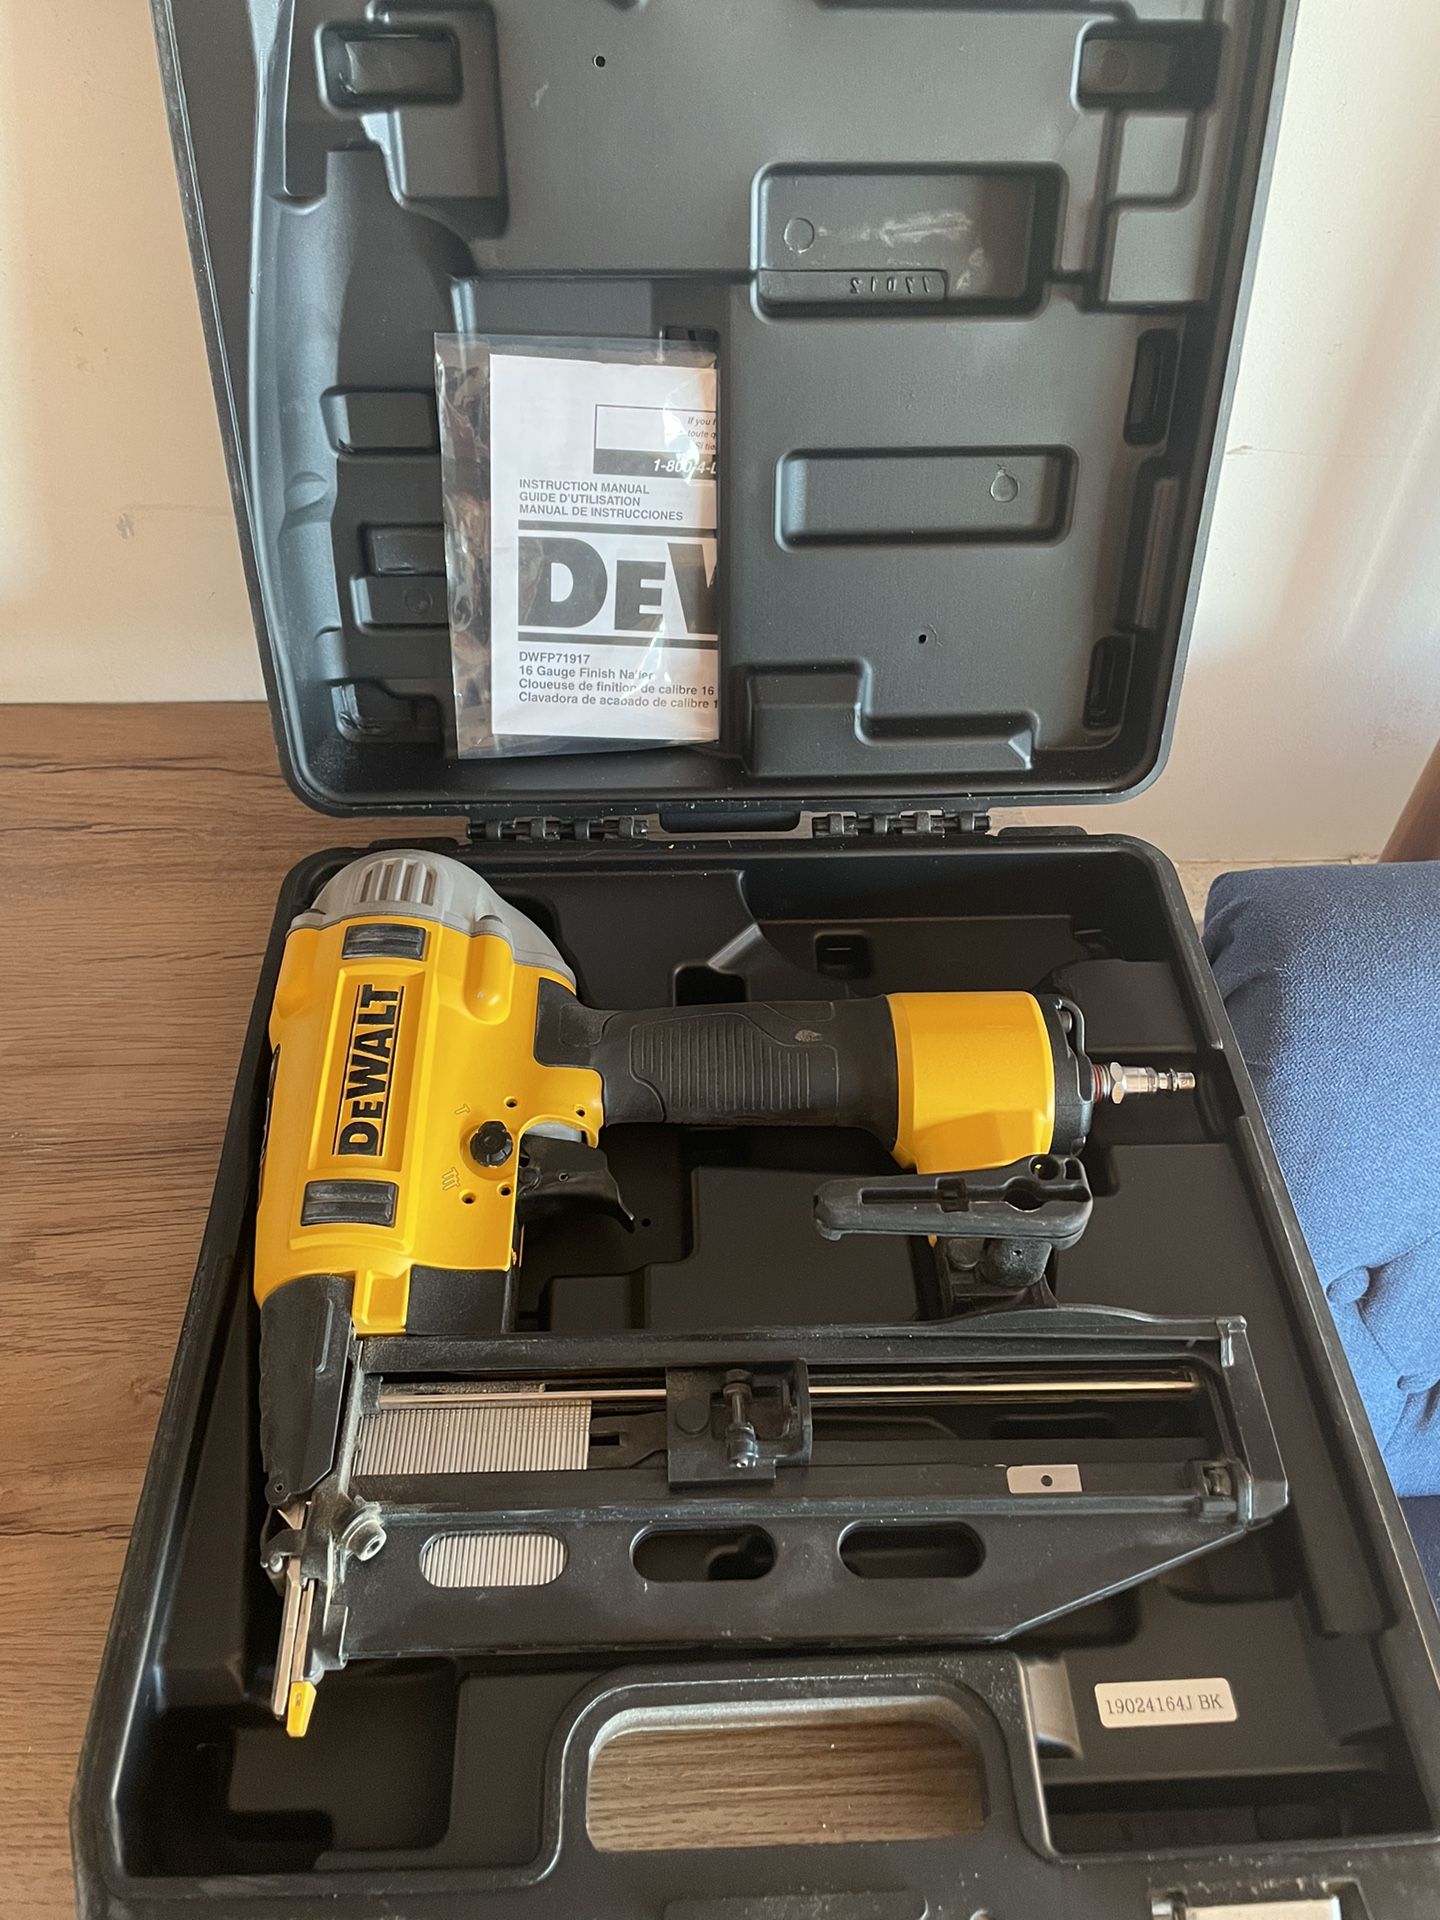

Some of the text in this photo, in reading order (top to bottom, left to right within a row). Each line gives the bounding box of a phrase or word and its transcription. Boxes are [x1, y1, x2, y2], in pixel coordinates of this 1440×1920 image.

[695, 418, 711, 427] you
[519, 479, 650, 495] INSTRUCTION MANUAL
[519, 491, 641, 506] GUIDE D'UTILISATION
[519, 504, 684, 521] MANUAL DE INSTRUCCIONES
[519, 651, 591, 664] DWFP71917
[519, 665, 533, 676] 16
[536, 666, 576, 679] Gauge
[579, 667, 616, 679] Finish
[518, 678, 575, 690] Cloueuse
[578, 680, 593, 691] de
[640, 683, 655, 694] de
[658, 684, 698, 695] calibre
[702, 685, 715, 696] 16
[518, 691, 578, 704] Clavadora
[581, 693, 596, 705] de
[652, 696, 667, 707] de
[670, 698, 710, 709] calibre
[338, 984, 399, 1155] DEWALT
[1198, 1694, 1224, 1710] BK
